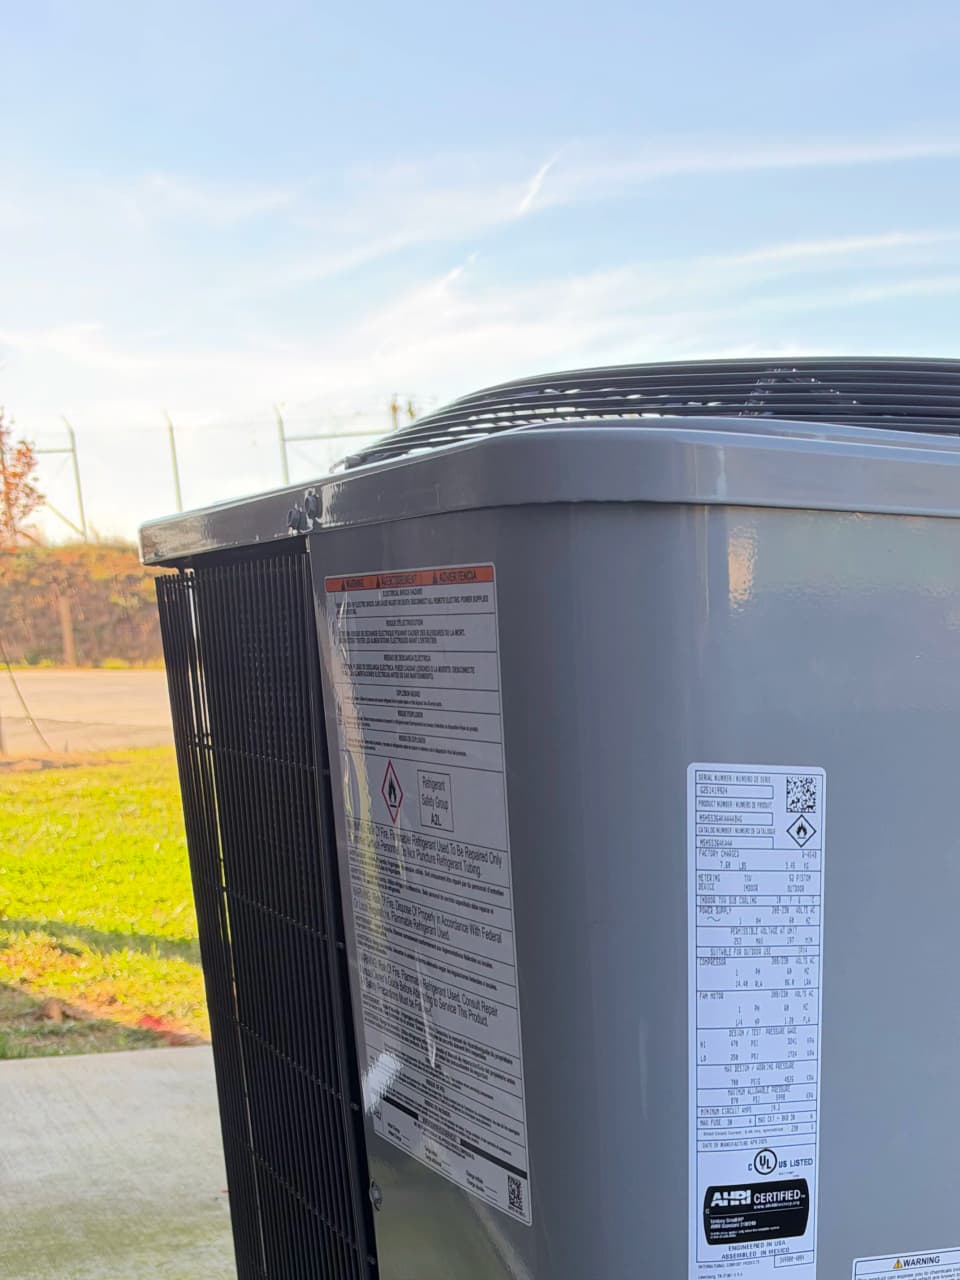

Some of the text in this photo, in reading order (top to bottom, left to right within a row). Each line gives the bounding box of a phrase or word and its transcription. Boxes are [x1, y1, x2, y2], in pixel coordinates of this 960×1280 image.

[422, 776, 446, 794] Refrigerant
[421, 794, 449, 811] Safety Group
[489, 852, 502, 868] Only
[481, 926, 502, 945] Federal
[457, 1005, 468, 1020] This
[759, 1155, 772, 1169] UL
[778, 1160, 787, 1168] US
[789, 1158, 813, 1167] LISTED
[754, 1190, 801, 1204] CERTIFIED
[903, 1255, 940, 1267] WARNING
